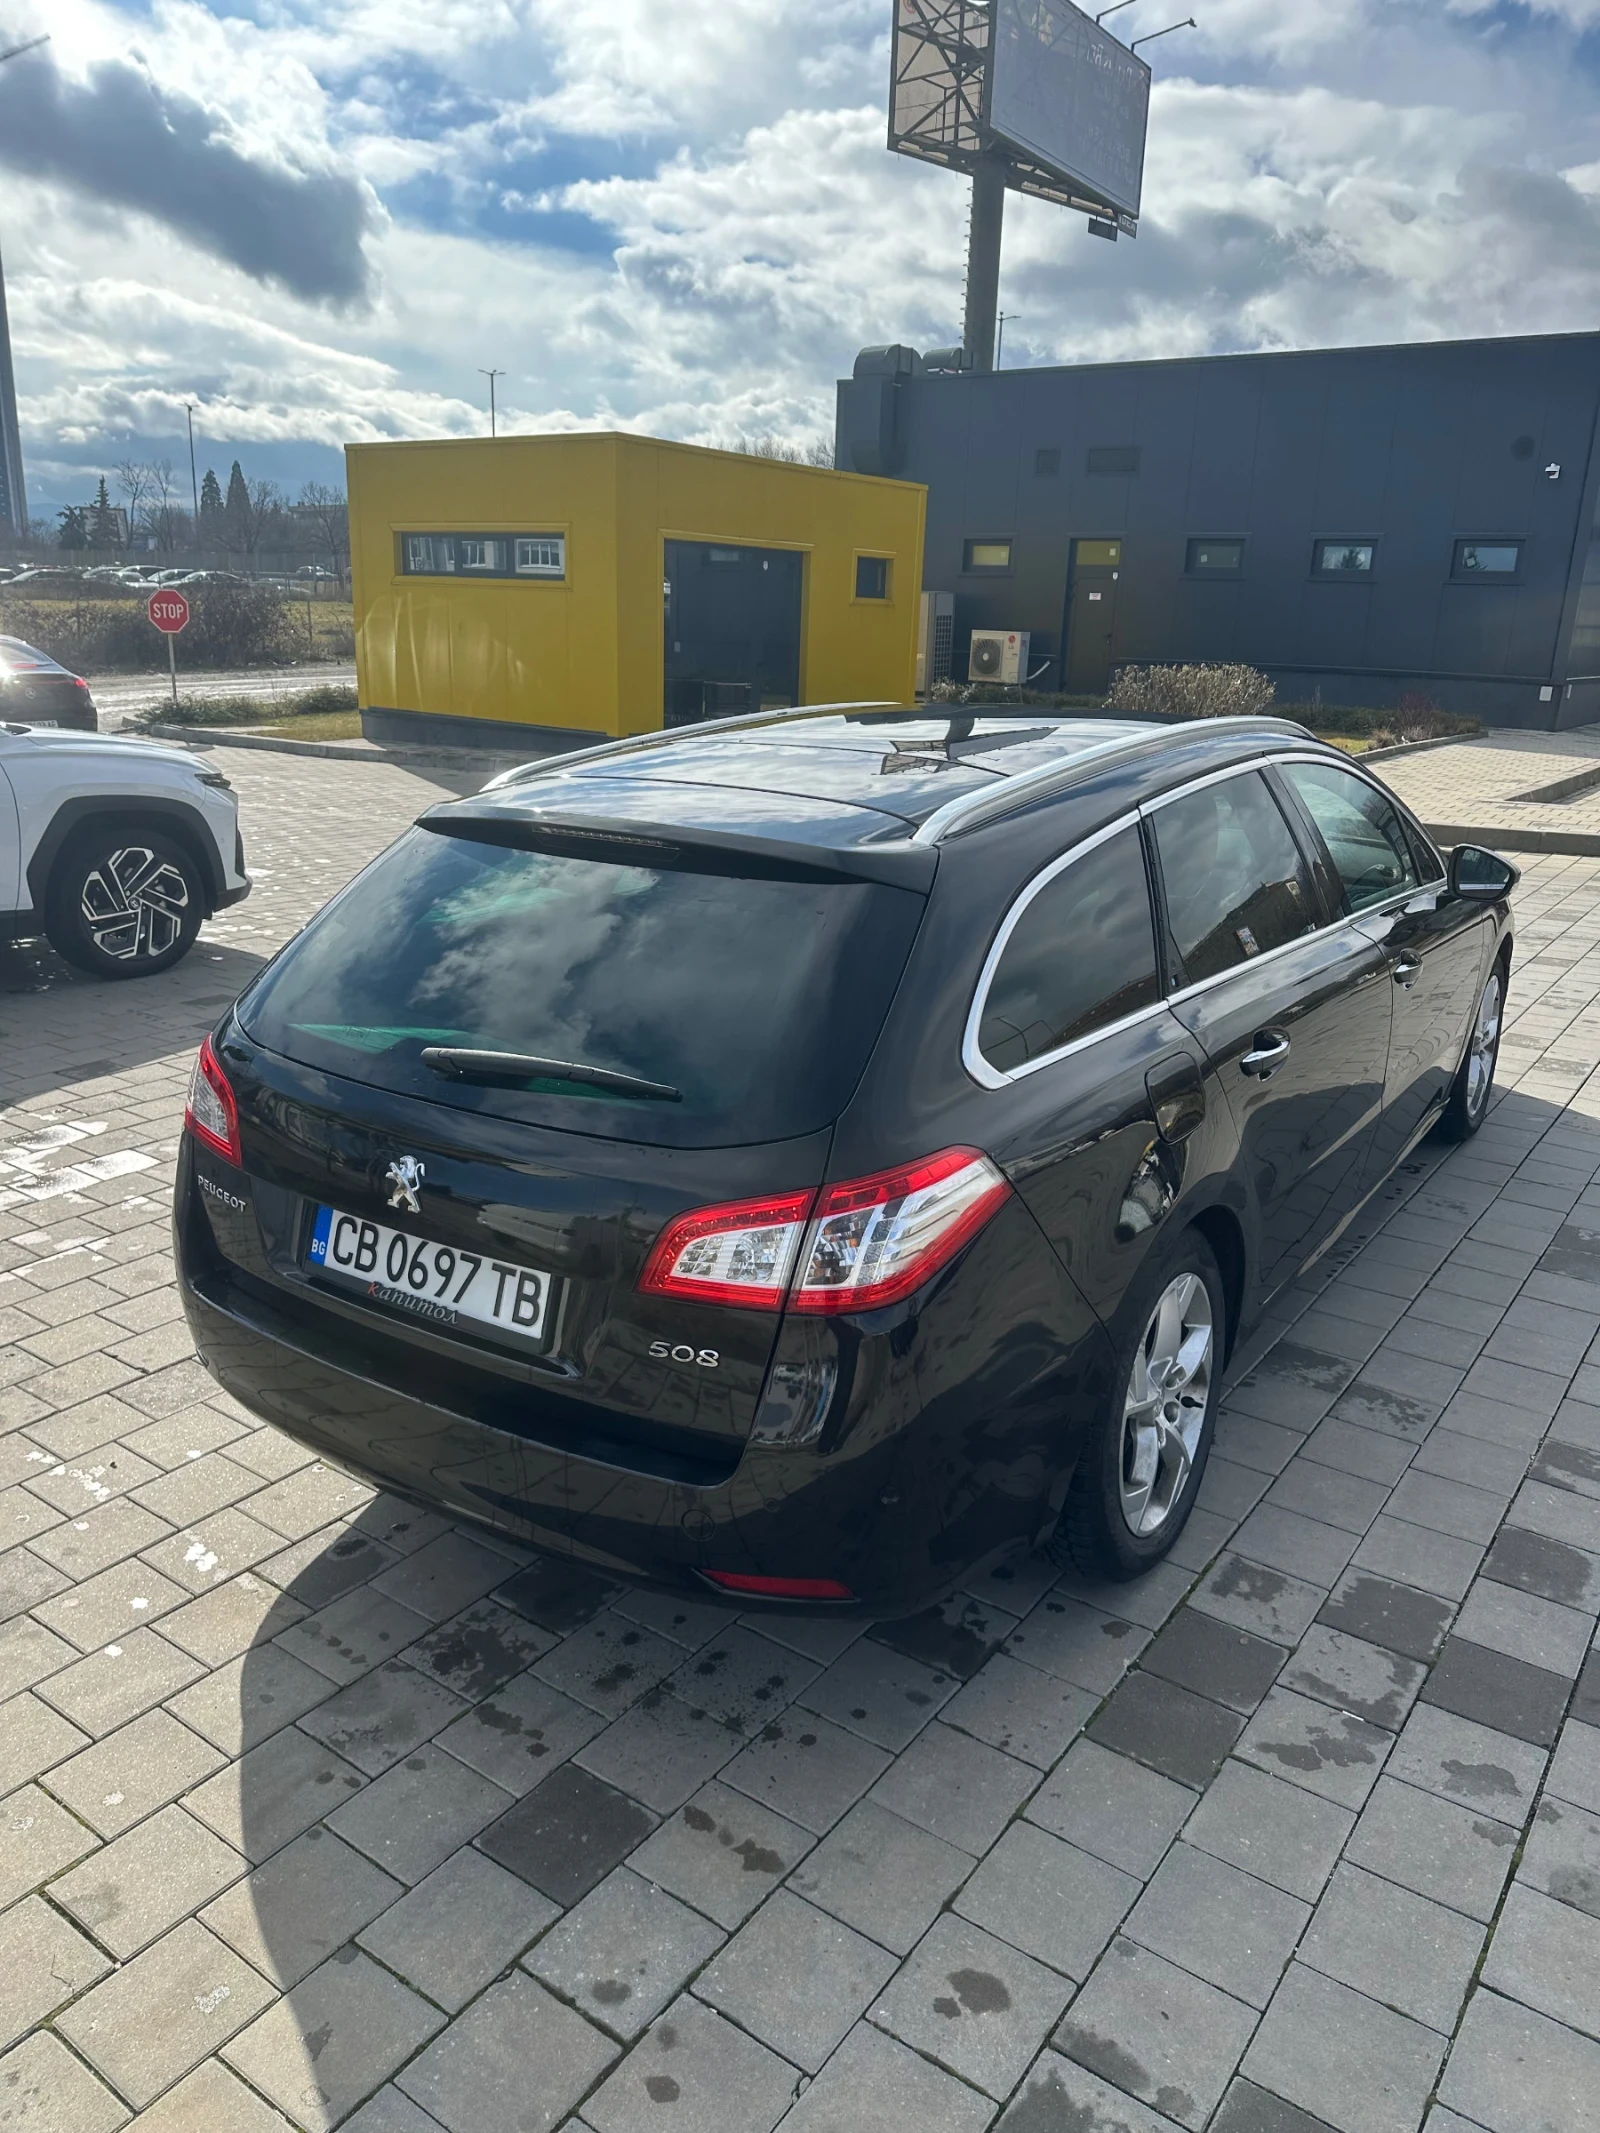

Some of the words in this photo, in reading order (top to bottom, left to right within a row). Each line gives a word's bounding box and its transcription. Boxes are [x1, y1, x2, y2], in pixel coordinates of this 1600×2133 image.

[153, 603, 184, 619] STOP
[197, 1173, 247, 1212] PEUGEOT
[311, 1238, 326, 1255] BG
[333, 1216, 379, 1273] CB
[387, 1234, 482, 1304] 0697
[492, 1262, 542, 1327] TB
[648, 1339, 720, 1368] 508
